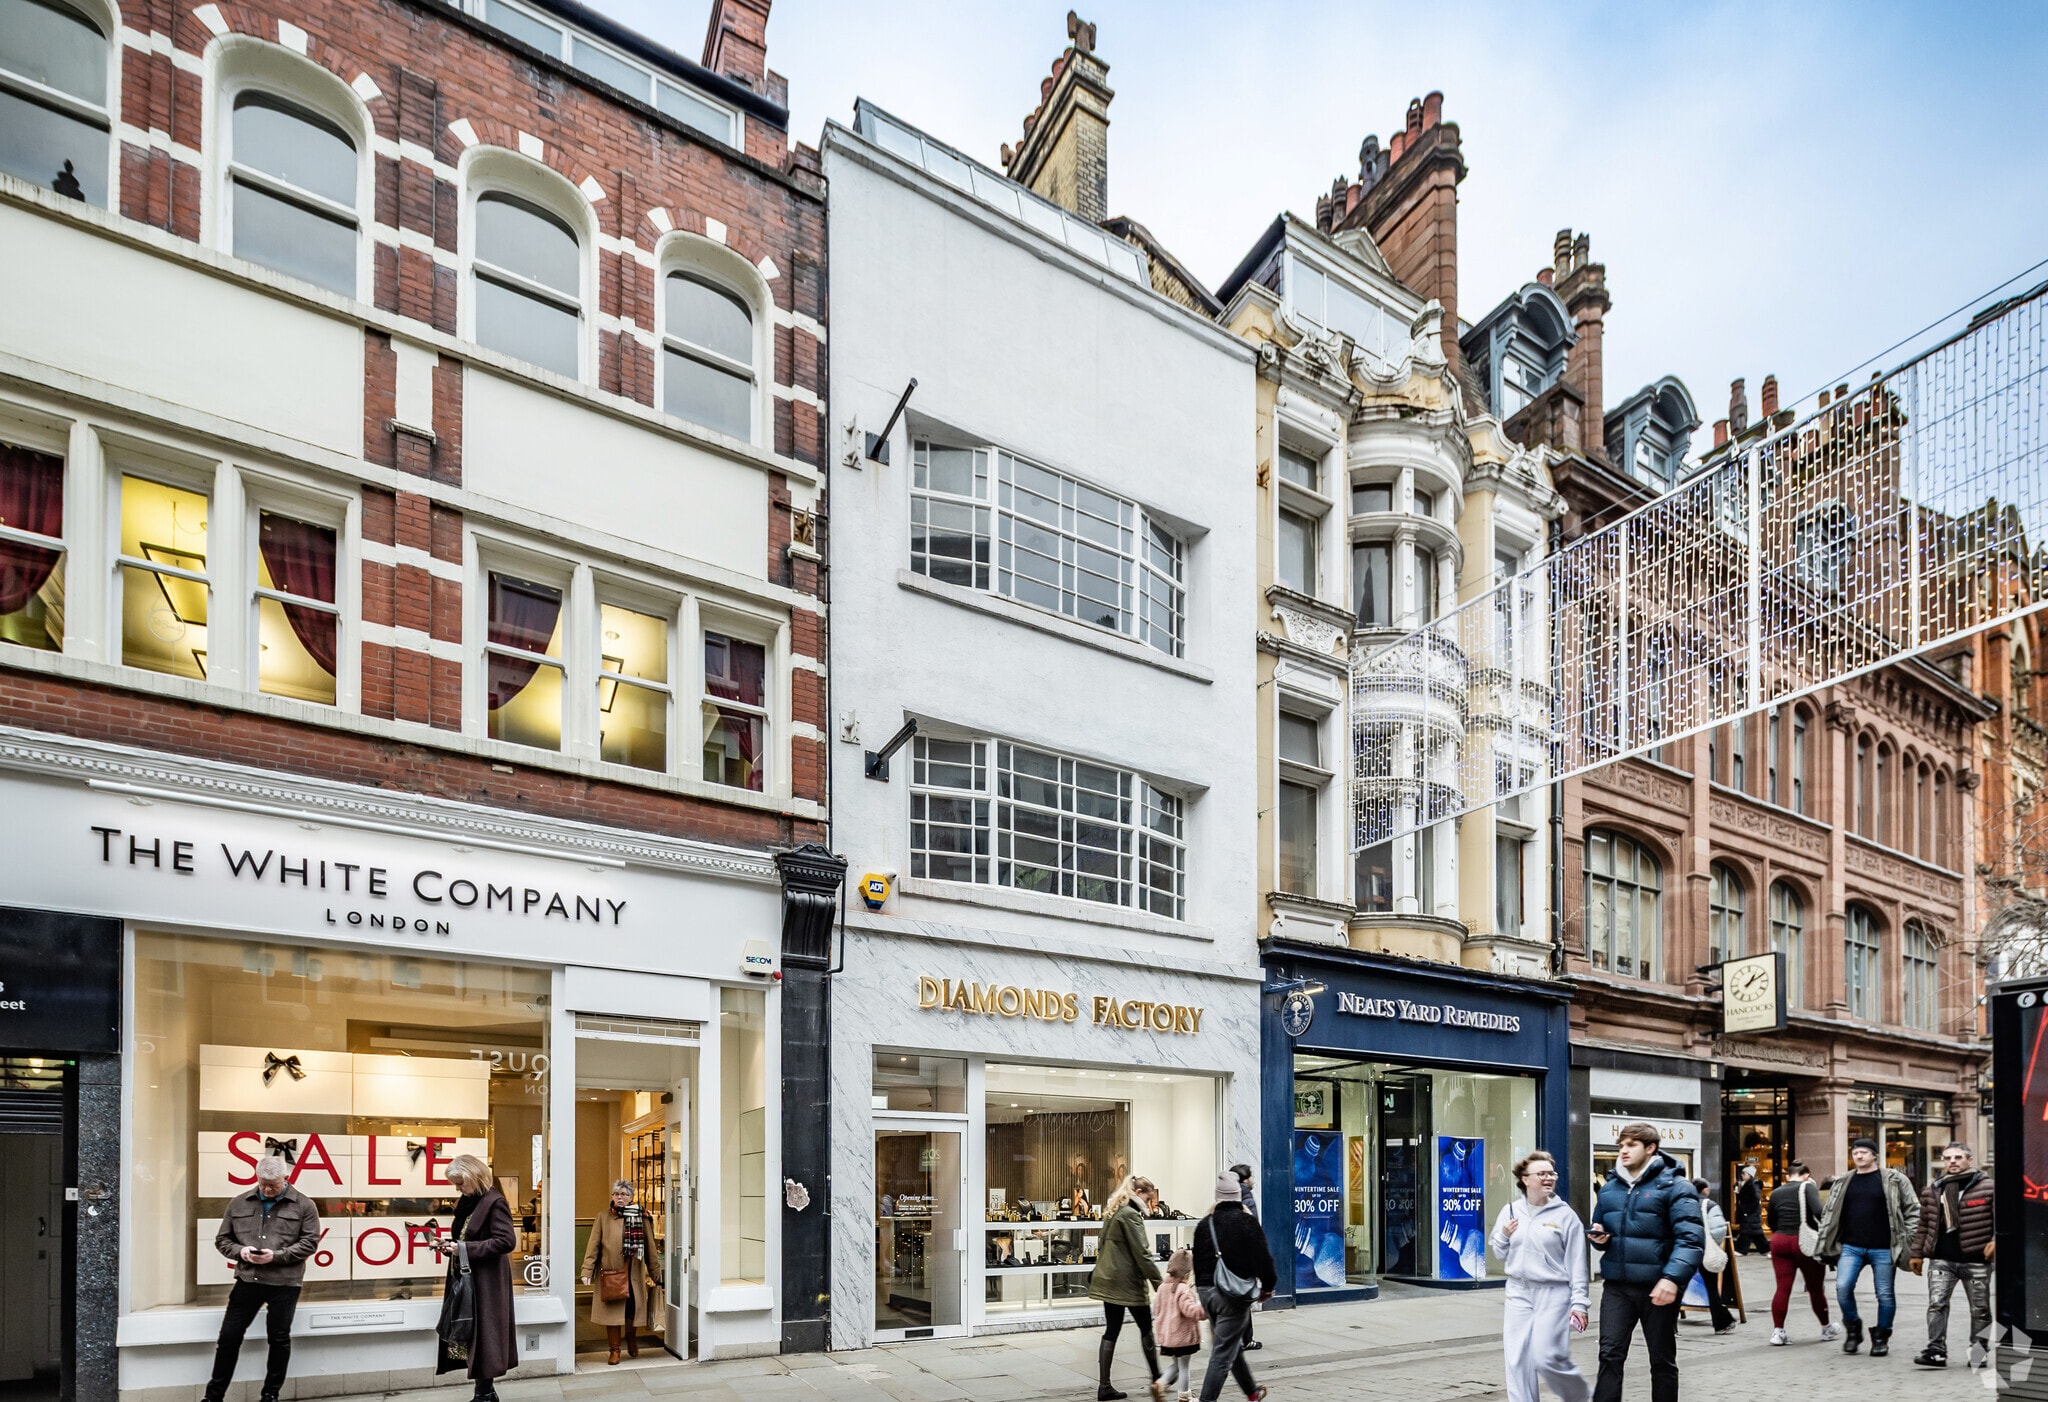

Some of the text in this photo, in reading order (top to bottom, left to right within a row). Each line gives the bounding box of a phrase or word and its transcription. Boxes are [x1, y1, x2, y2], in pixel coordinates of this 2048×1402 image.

[91, 825, 627, 925] THE WHITE COMPANY
[870, 882, 883, 892] ADT
[326, 908, 450, 935] LONDON
[746, 956, 772, 965] SECOM
[918, 975, 1204, 1034] DIAMONDS FACTORY
[1726, 1002, 1774, 1016] HANCOCKS
[1336, 991, 1520, 1033] NEAL'S YARD REMEDIES
[1611, 1124, 1684, 1140] HCKS
[228, 1131, 457, 1186] SALE
[899, 1193, 920, 1203] Opening
[1442, 1199, 1482, 1211] 30% OFF
[327, 1203, 346, 1213] UP
[1294, 1199, 1340, 1213] 30% OFF
